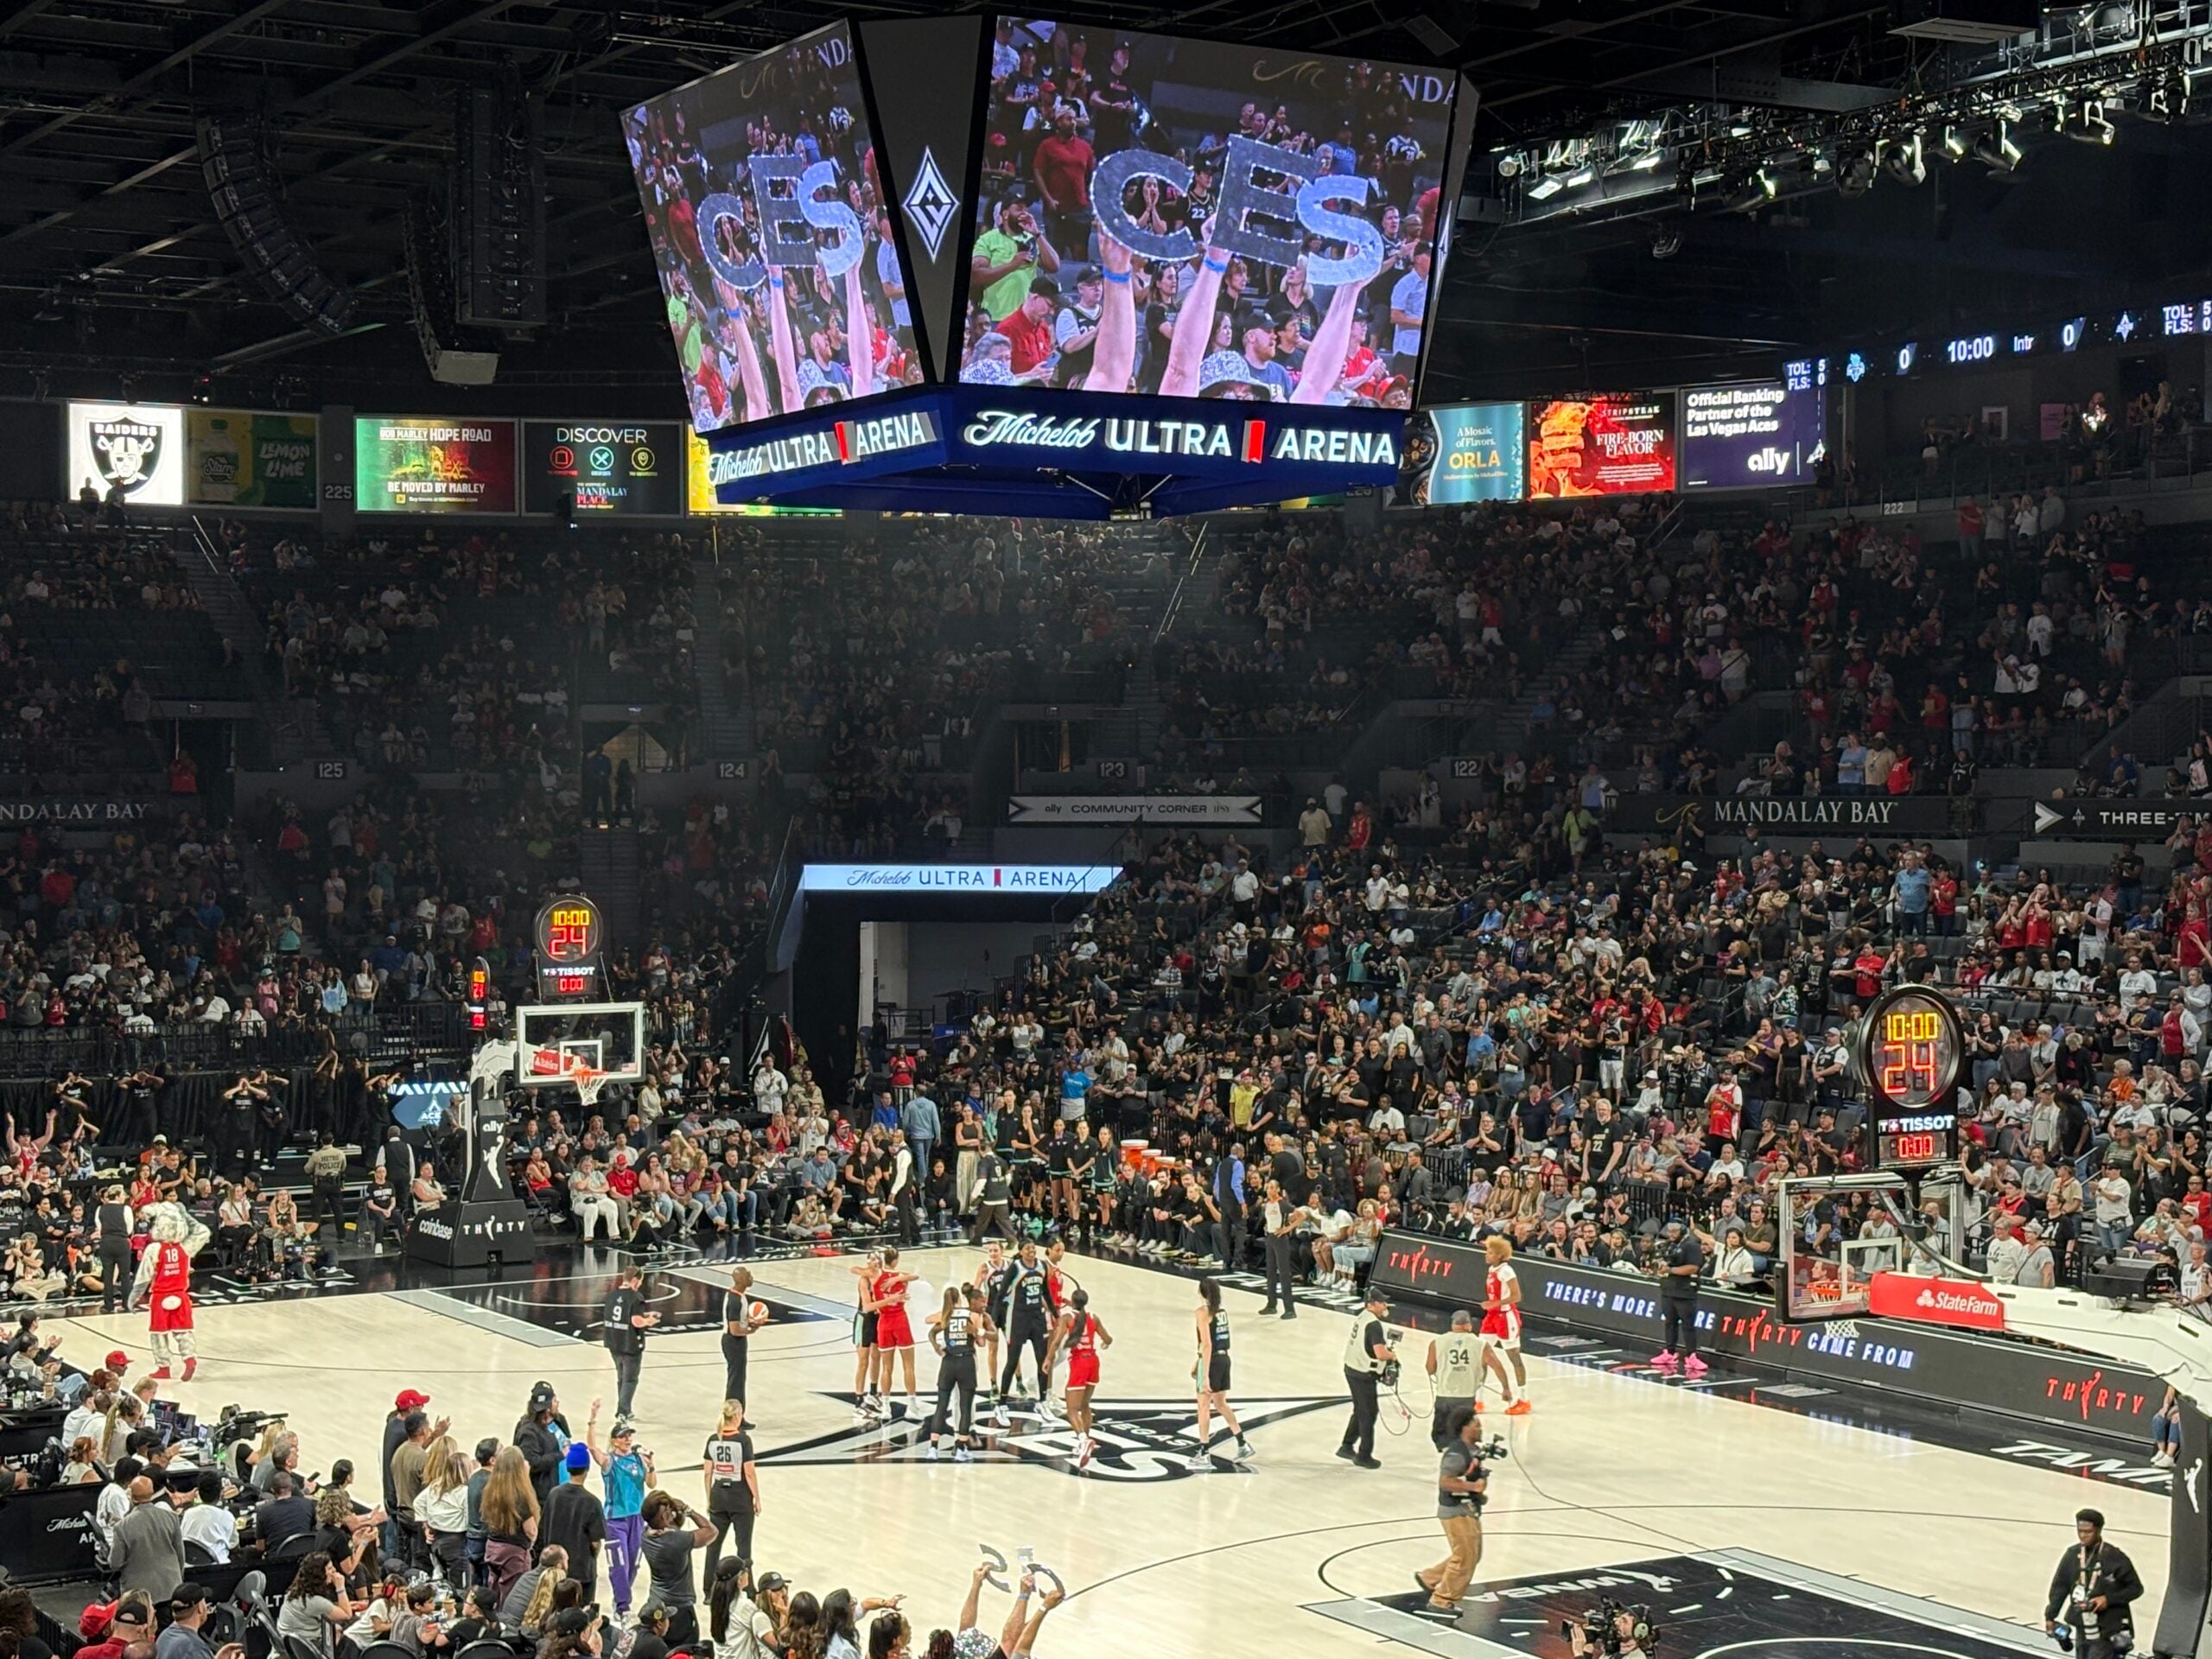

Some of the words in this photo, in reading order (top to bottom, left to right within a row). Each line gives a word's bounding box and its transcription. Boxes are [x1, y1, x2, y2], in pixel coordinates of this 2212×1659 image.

[1192, 208, 1206, 219] 22
[2163, 305, 2193, 321] TOL:
[2063, 324, 2075, 346] 0
[2165, 320, 2193, 335] FLS:
[1900, 348, 1910, 368] 0
[1948, 336, 1994, 363] 10:00
[1787, 363, 1811, 377] TOL:
[1818, 359, 1826, 372] 5
[1789, 377, 1811, 391] FLS:
[1818, 373, 1826, 385] 0
[1688, 392, 1733, 407] Official
[1733, 389, 1785, 404] Banking
[1688, 407, 1733, 422] Partner
[1734, 405, 1749, 419] of
[1750, 404, 1772, 417] the
[94, 422, 158, 436] RAIDERS
[397, 429, 429, 440] MARLEY
[430, 429, 461, 442] HOPE
[462, 429, 492, 442] ROAD
[556, 427, 648, 443] DISCOVER
[1458, 428, 1464, 436] A
[1464, 426, 1493, 436] Mosaic
[1688, 424, 1708, 436] Las
[1709, 423, 1747, 437] Vegas
[1747, 420, 1779, 433] Aces
[965, 411, 1101, 448] Michelob
[1108, 418, 1231, 456] ULTRA
[1277, 429, 1396, 469] ARENA
[1456, 438, 1465, 448] of
[1597, 430, 1664, 446] FIRE-BORN
[260, 442, 310, 461] LEMON
[709, 446, 764, 486] Michelob
[766, 432, 834, 473] ULTRA
[856, 413, 927, 456] ARENA
[1606, 442, 1655, 457] FLAVOR
[1449, 450, 1501, 470] ORLA
[1748, 448, 1789, 475] ally
[324, 485, 353, 499] 225
[388, 482, 400, 493] BE
[402, 482, 434, 493] MOVED
[435, 482, 448, 493] BY
[449, 482, 486, 493] MARLEY
[577, 486, 629, 498] MANDALAY
[577, 495, 608, 505] PLACE
[1884, 503, 1904, 515] 222
[319, 762, 345, 779] 125
[720, 763, 746, 778] 124
[1101, 762, 1125, 778] 123
[1454, 760, 1478, 777] 122
[105, 804, 148, 820] BAY
[1045, 803, 1062, 815] ally
[1071, 804, 1154, 814] COMMUNITY
[1159, 804, 1208, 814] CORNER
[1714, 801, 1845, 823] MANDALAY
[847, 869, 914, 886] Michelob
[920, 869, 986, 887] ULTRA
[1011, 870, 1079, 887] ARENA
[554, 910, 590, 926] 10:00
[550, 926, 588, 956] 24
[557, 966, 596, 976] TISSOT
[1887, 1013, 1938, 1042] 10:00
[1882, 1042, 1935, 1094] 24
[482, 1121, 505, 1134] ally
[1899, 1115, 1955, 1132] TISSOT
[1898, 1135, 1934, 1159] 0:00
[419, 1216, 454, 1242] coinbase
[166, 1249, 180, 1262] 18
[1026, 1284, 1040, 1297] 35
[1545, 1281, 1607, 1308] THERE'S
[1611, 1294, 1656, 1318] MORE
[612, 1306, 623, 1321] 9
[1449, 1349, 1470, 1365] 34
[1807, 1332, 1857, 1357] CAME
[1862, 1342, 1915, 1370] FROM
[1096, 1417, 1197, 1446] VEGAS
[716, 1446, 732, 1463] 26
[1462, 1576, 1636, 1603] WNBA
